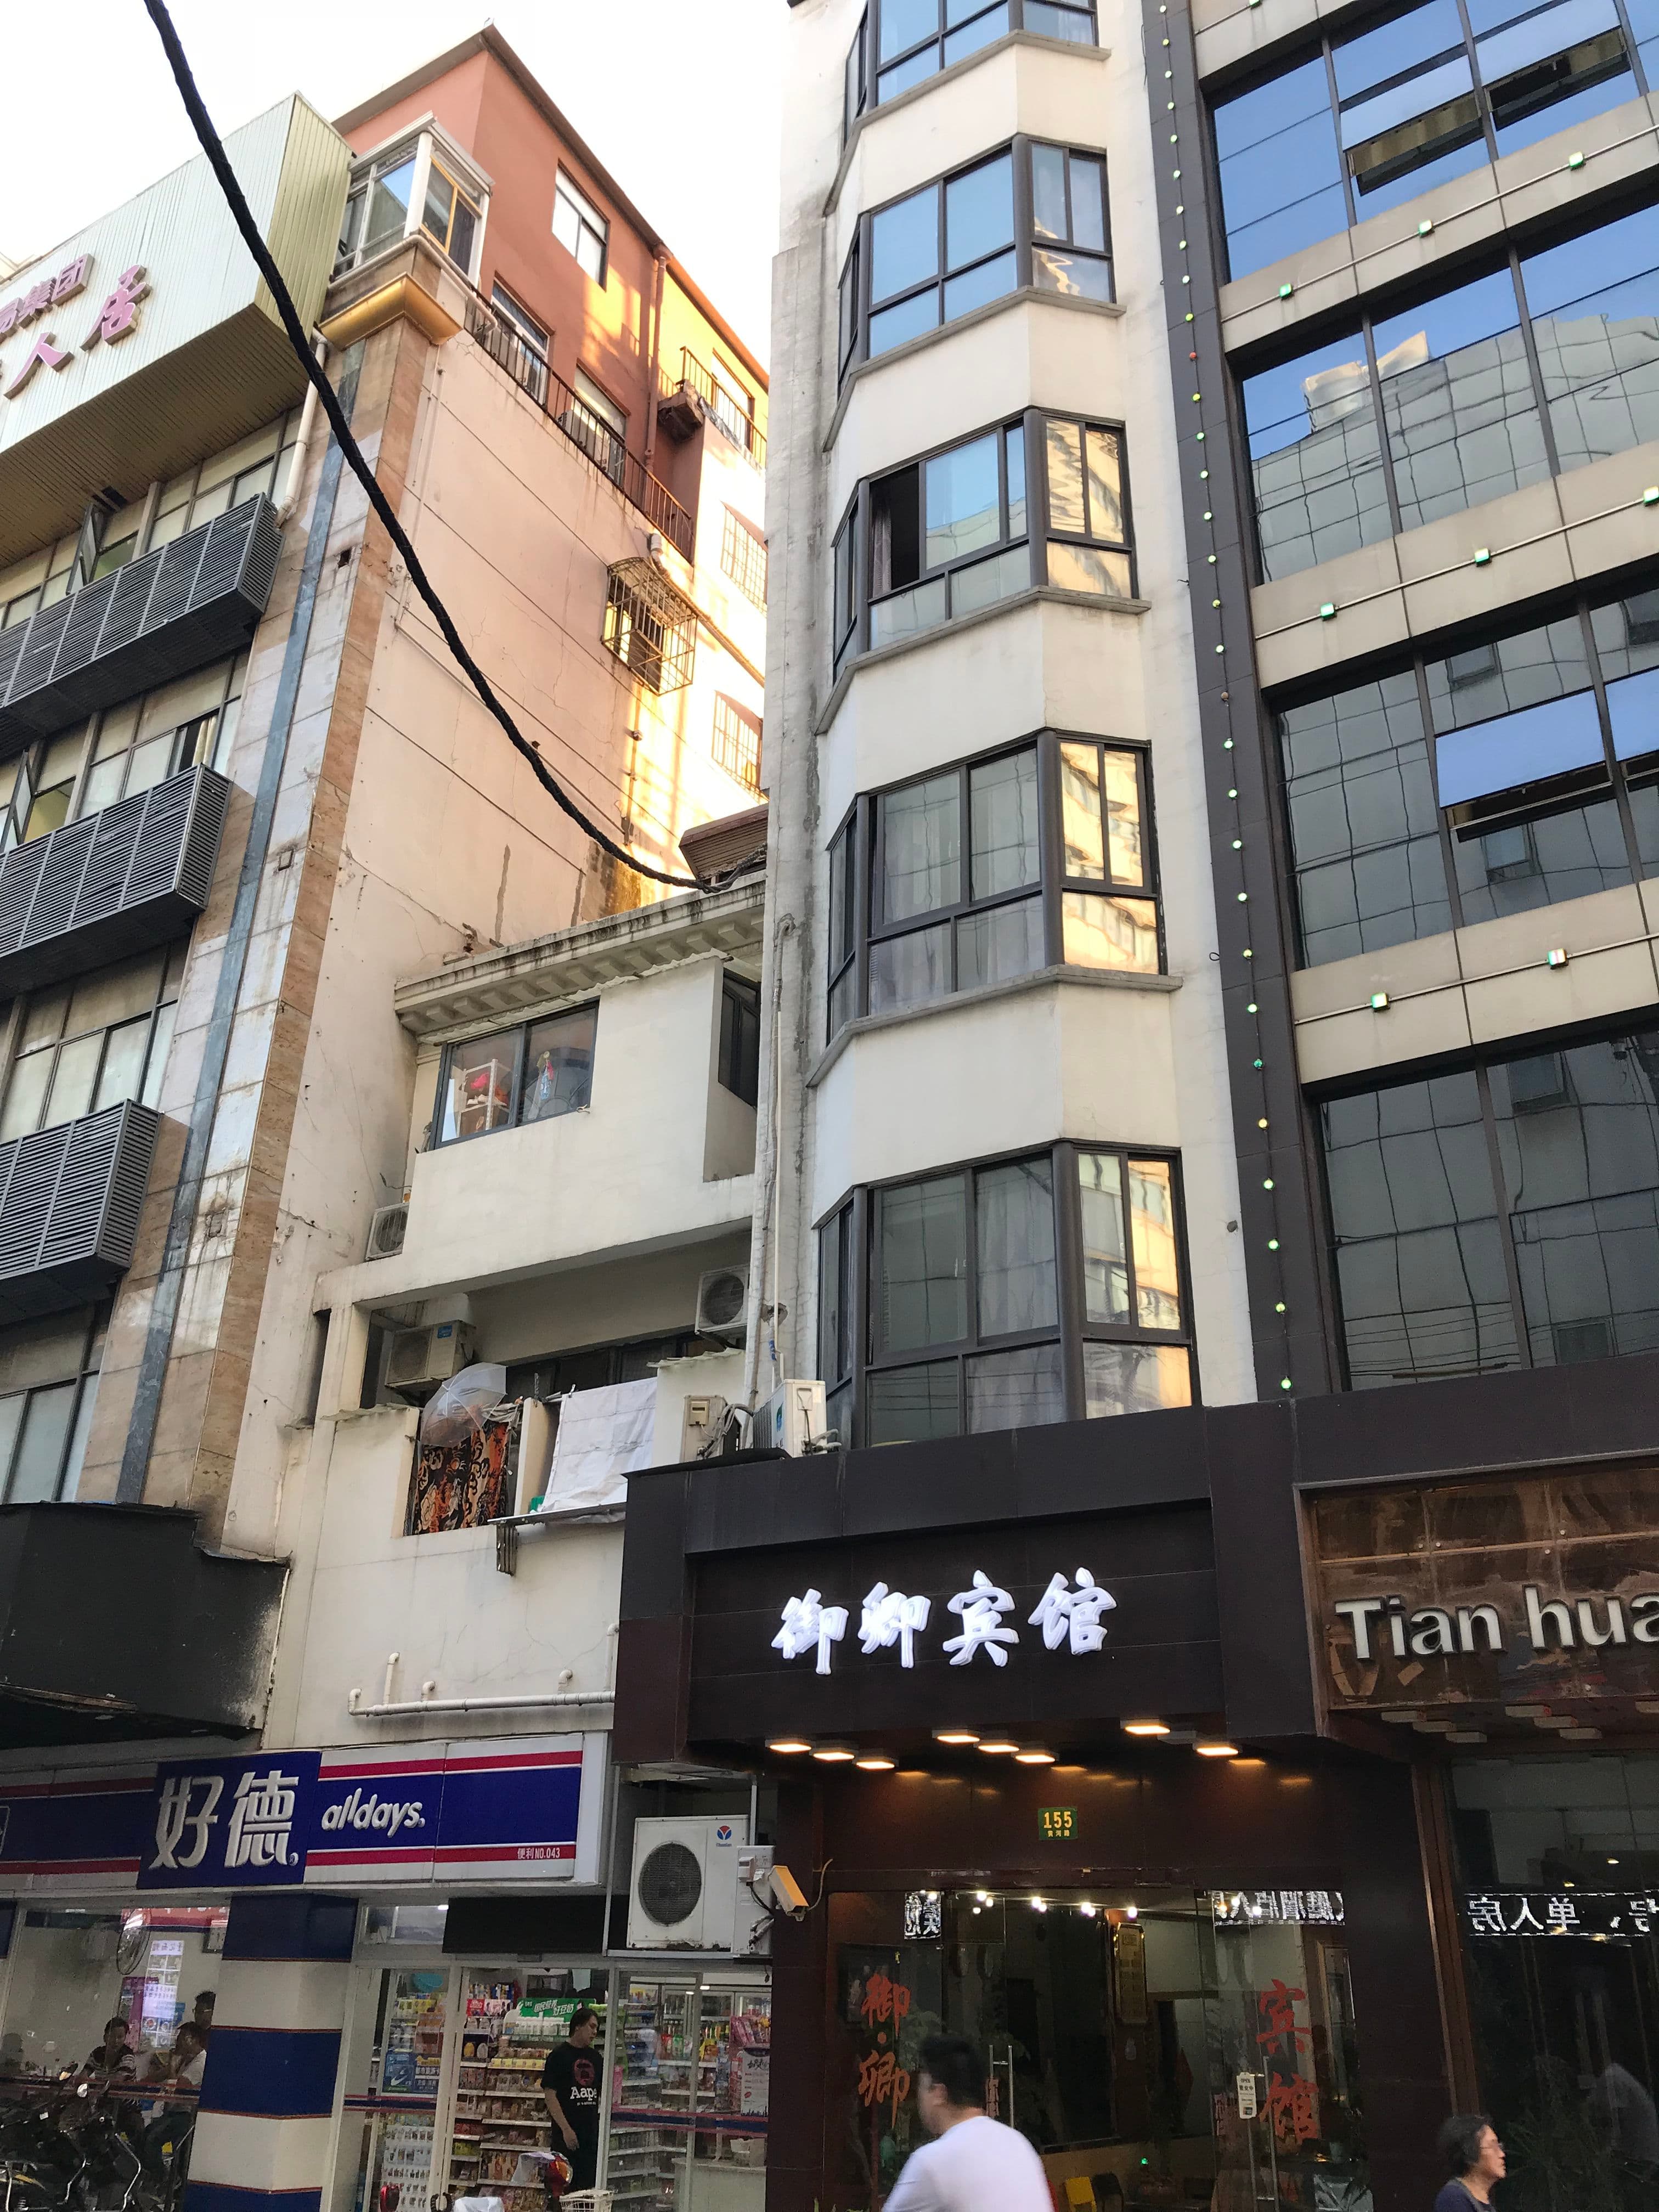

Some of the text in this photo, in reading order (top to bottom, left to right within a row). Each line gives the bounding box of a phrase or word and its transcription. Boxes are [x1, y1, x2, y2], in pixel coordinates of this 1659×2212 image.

[1335, 1592, 1506, 1661] Tian
[149, 1769, 300, 1870] 好德
[1043, 1811, 1073, 1829] 155
